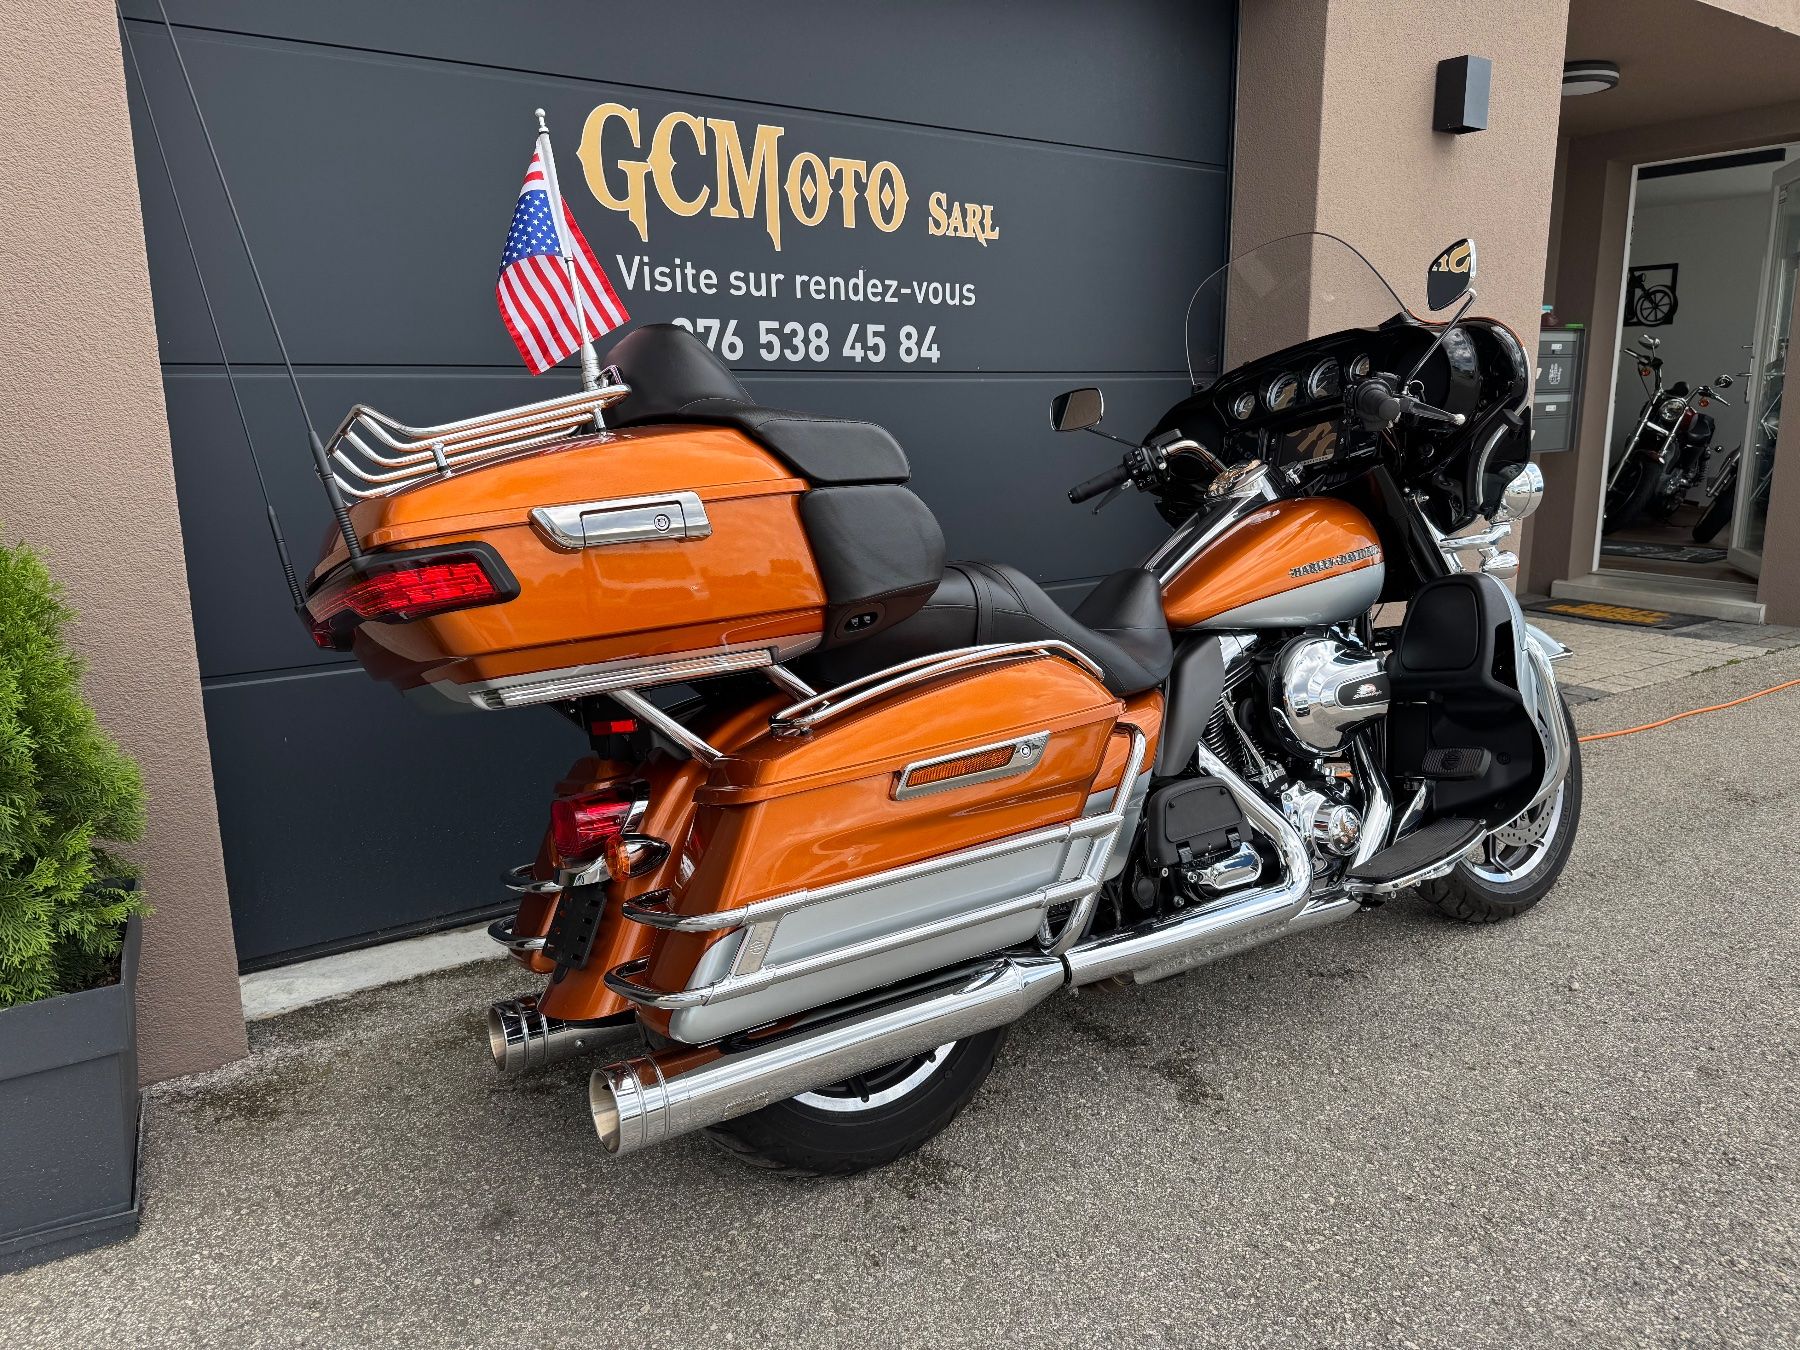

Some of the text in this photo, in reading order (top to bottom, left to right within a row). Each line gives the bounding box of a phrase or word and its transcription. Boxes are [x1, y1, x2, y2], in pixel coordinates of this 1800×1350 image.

[616, 254, 976, 306] Visite sur rendez-vous
[758, 320, 830, 362] 538
[842, 323, 886, 363] 45
[899, 325, 941, 363] 84
